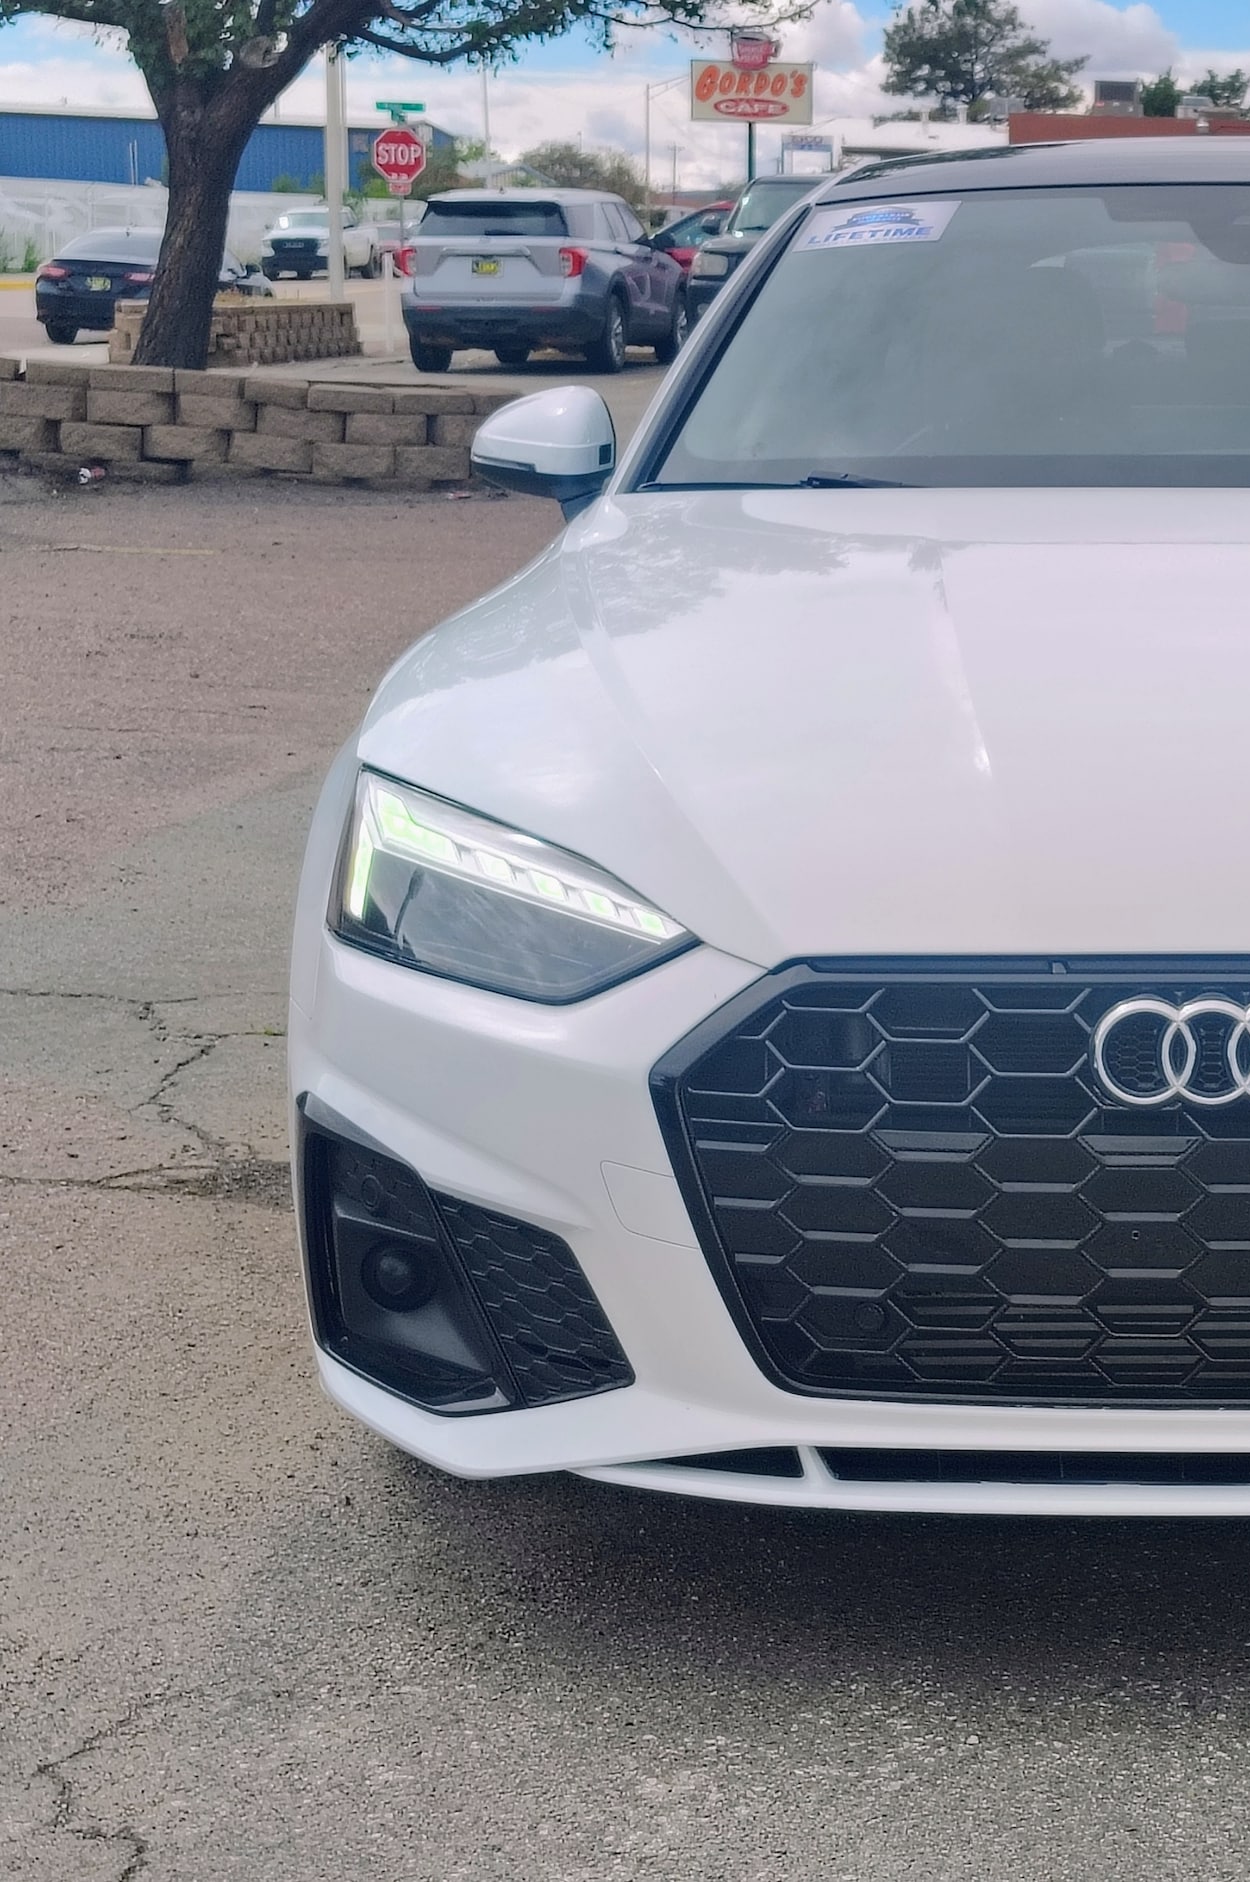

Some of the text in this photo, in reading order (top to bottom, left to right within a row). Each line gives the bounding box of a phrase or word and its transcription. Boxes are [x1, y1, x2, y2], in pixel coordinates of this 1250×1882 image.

[695, 65, 808, 102] GORDO'S
[719, 101, 783, 114] CAFE
[377, 143, 421, 166] STOP
[808, 226, 933, 244] LIFETIME
